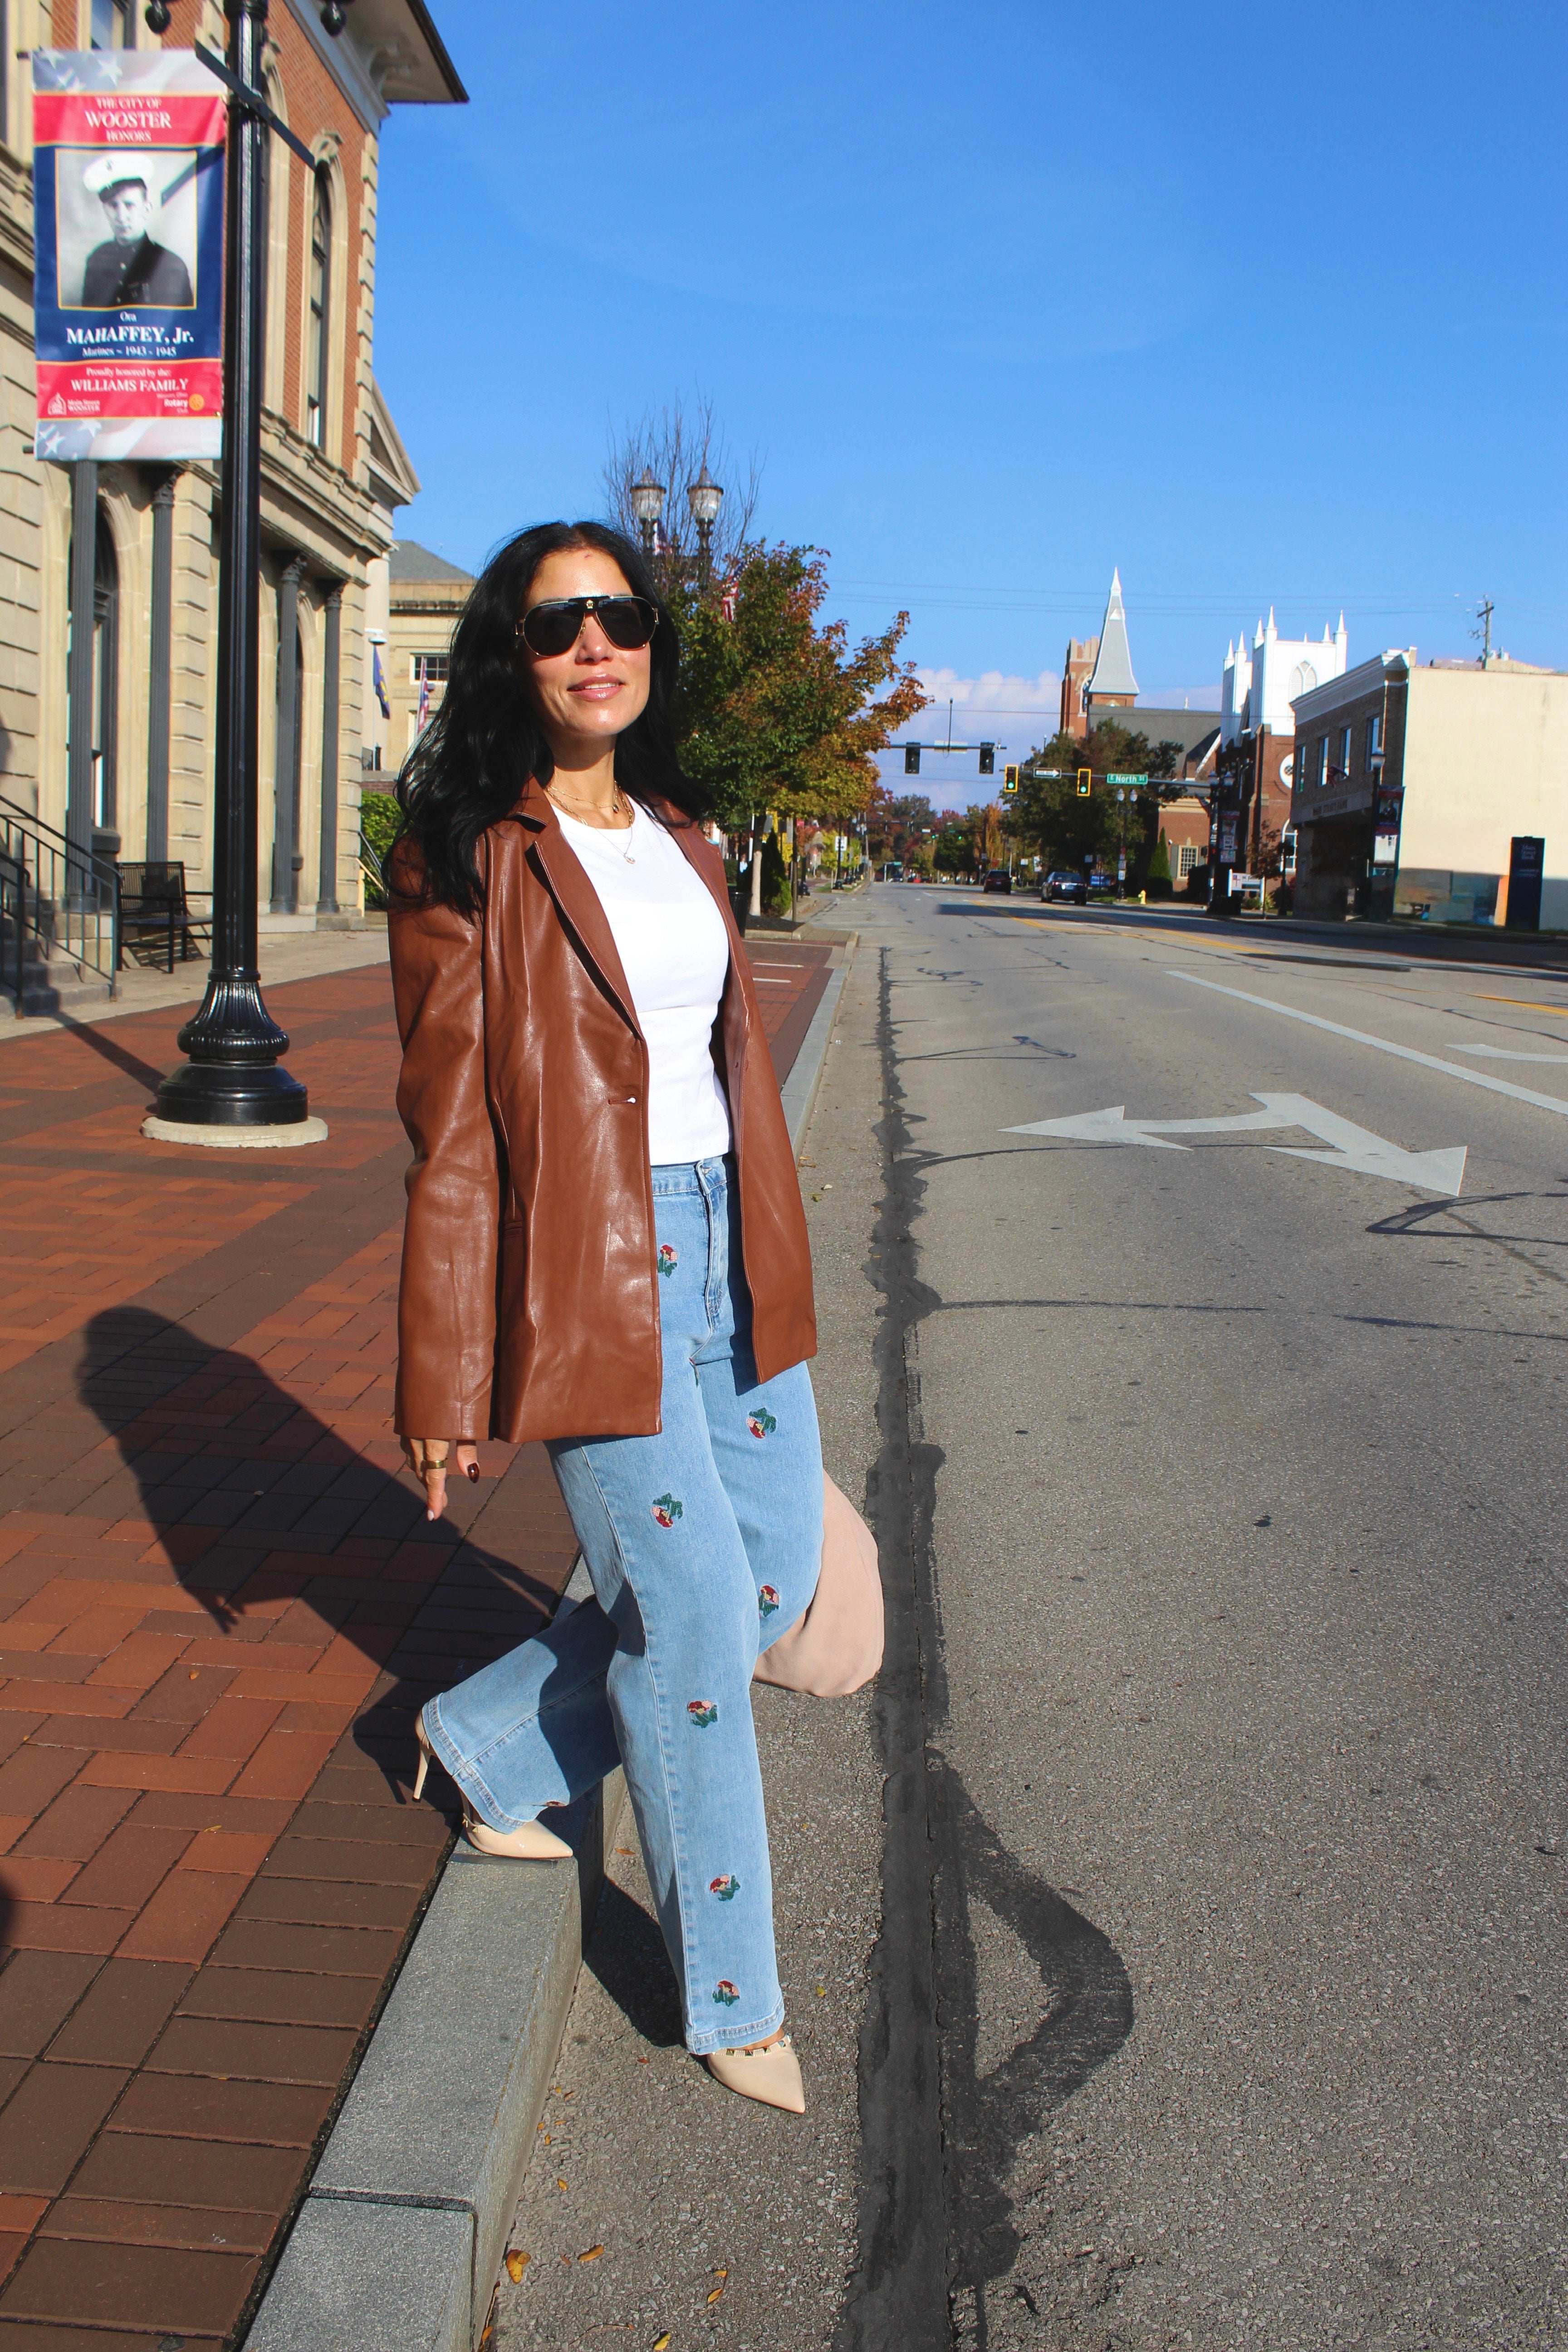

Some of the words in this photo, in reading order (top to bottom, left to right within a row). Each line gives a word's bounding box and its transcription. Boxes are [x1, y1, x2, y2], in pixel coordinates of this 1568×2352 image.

[95, 97, 118, 109] THE
[118, 97, 144, 109] CITY
[146, 97, 162, 109] OF
[84, 110, 172, 128] WOOSTER
[106, 129, 152, 142] HONORS
[66, 326, 170, 345] MAHAFFEY,
[172, 327, 194, 344] Jr.
[83, 346, 115, 358] Marines
[126, 345, 147, 357] 1943
[156, 346, 177, 357] 1945
[86, 367, 113, 377] Proudly
[115, 367, 146, 377] honored
[147, 368, 156, 379] by
[71, 379, 137, 392] WILLIAMS
[140, 378, 189, 392] FAMILY
[164, 399, 188, 408] Rotary
[1116, 774, 1137, 783] North
